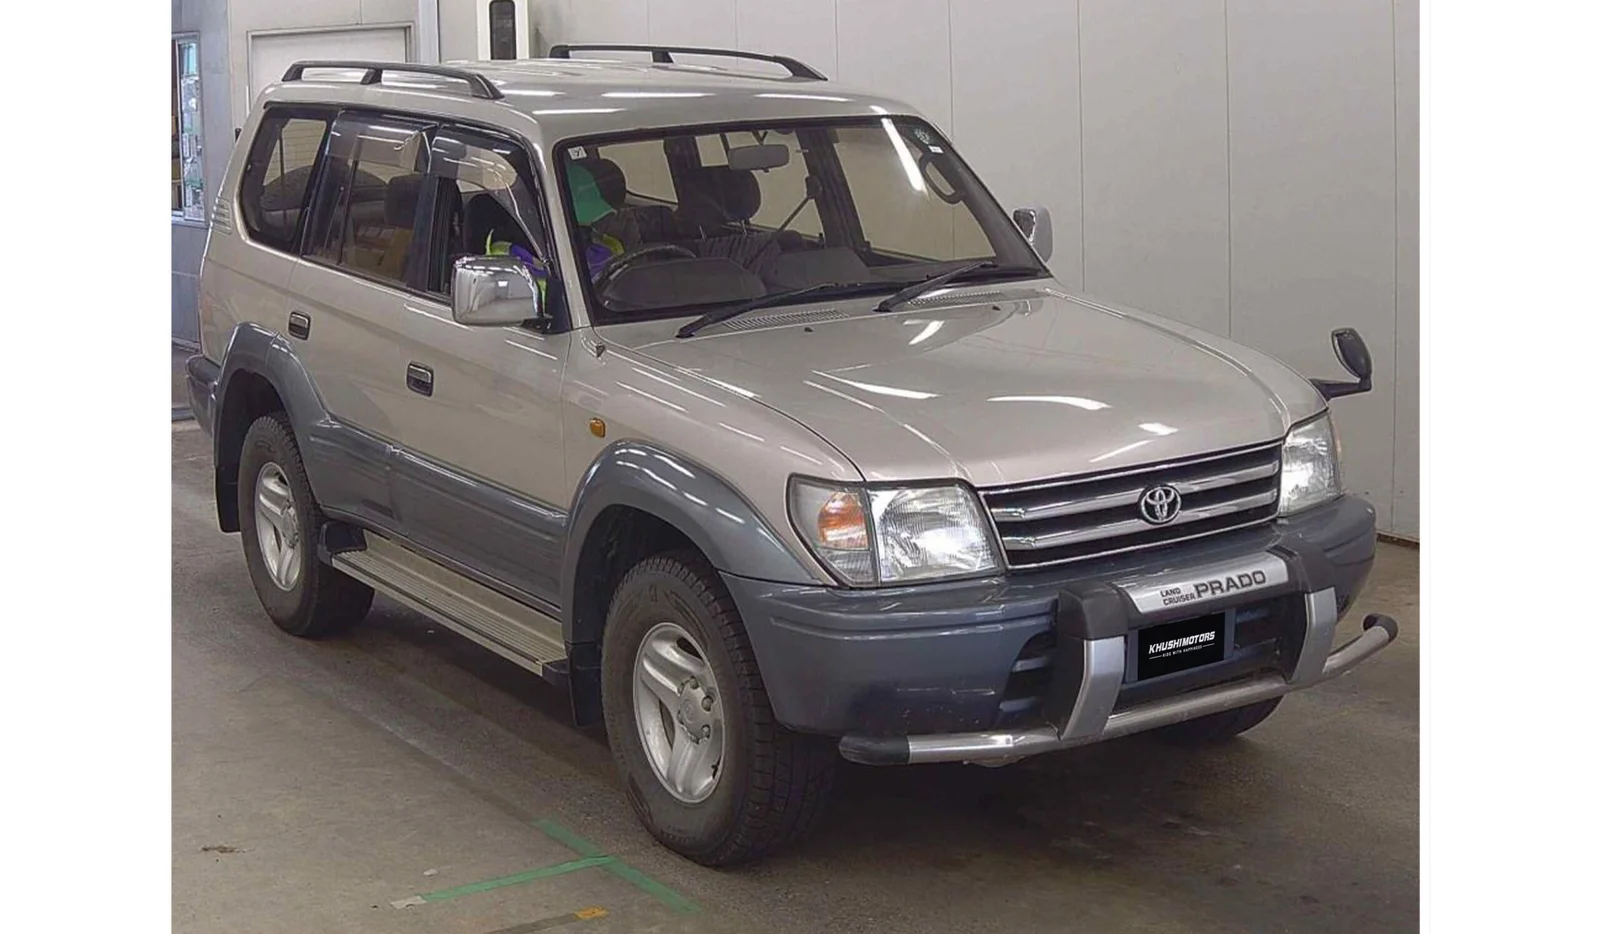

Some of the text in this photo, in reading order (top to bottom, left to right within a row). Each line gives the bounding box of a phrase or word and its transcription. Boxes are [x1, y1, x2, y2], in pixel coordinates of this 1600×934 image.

[1160, 587, 1181, 598] LAND
[1163, 570, 1267, 606] CRUISER PRADO
